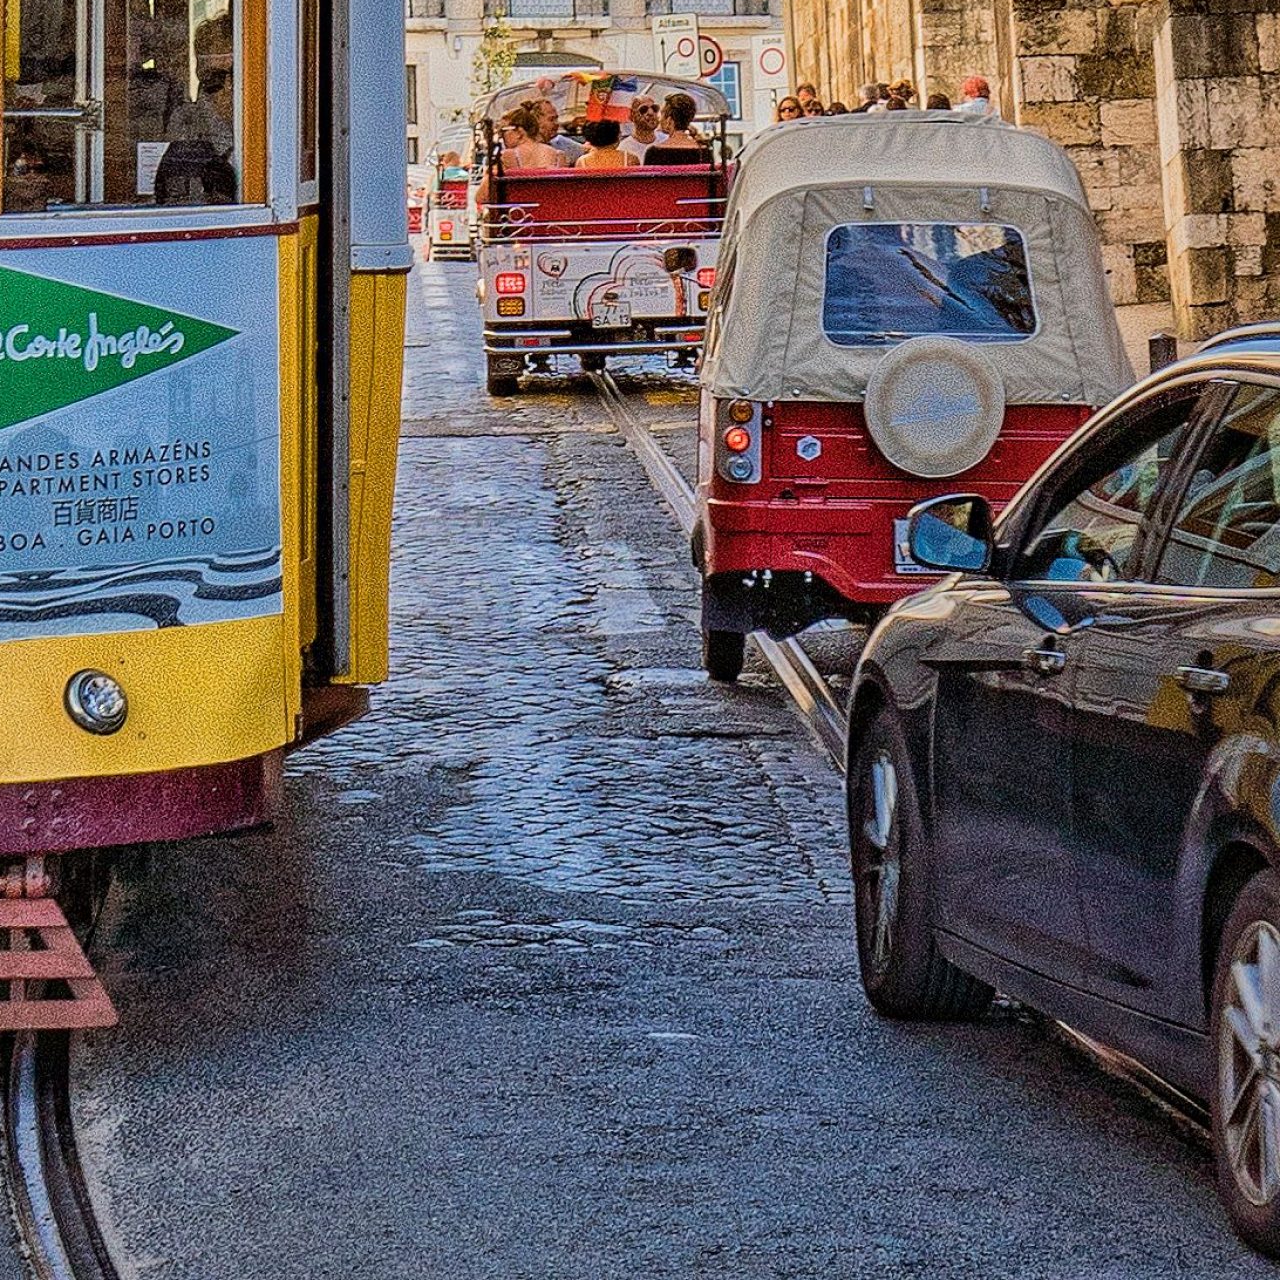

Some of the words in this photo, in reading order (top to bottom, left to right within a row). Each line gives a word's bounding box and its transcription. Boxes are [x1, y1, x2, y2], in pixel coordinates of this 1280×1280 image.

[5, 323, 81, 362] Corte
[83, 312, 185, 372] Inglés
[90, 439, 212, 468] ARMAZÉNS
[132, 465, 210, 489] STORES
[51, 496, 140, 527] 百貨商店
[76, 526, 136, 547] GAIA
[146, 517, 216, 541] PORTO
